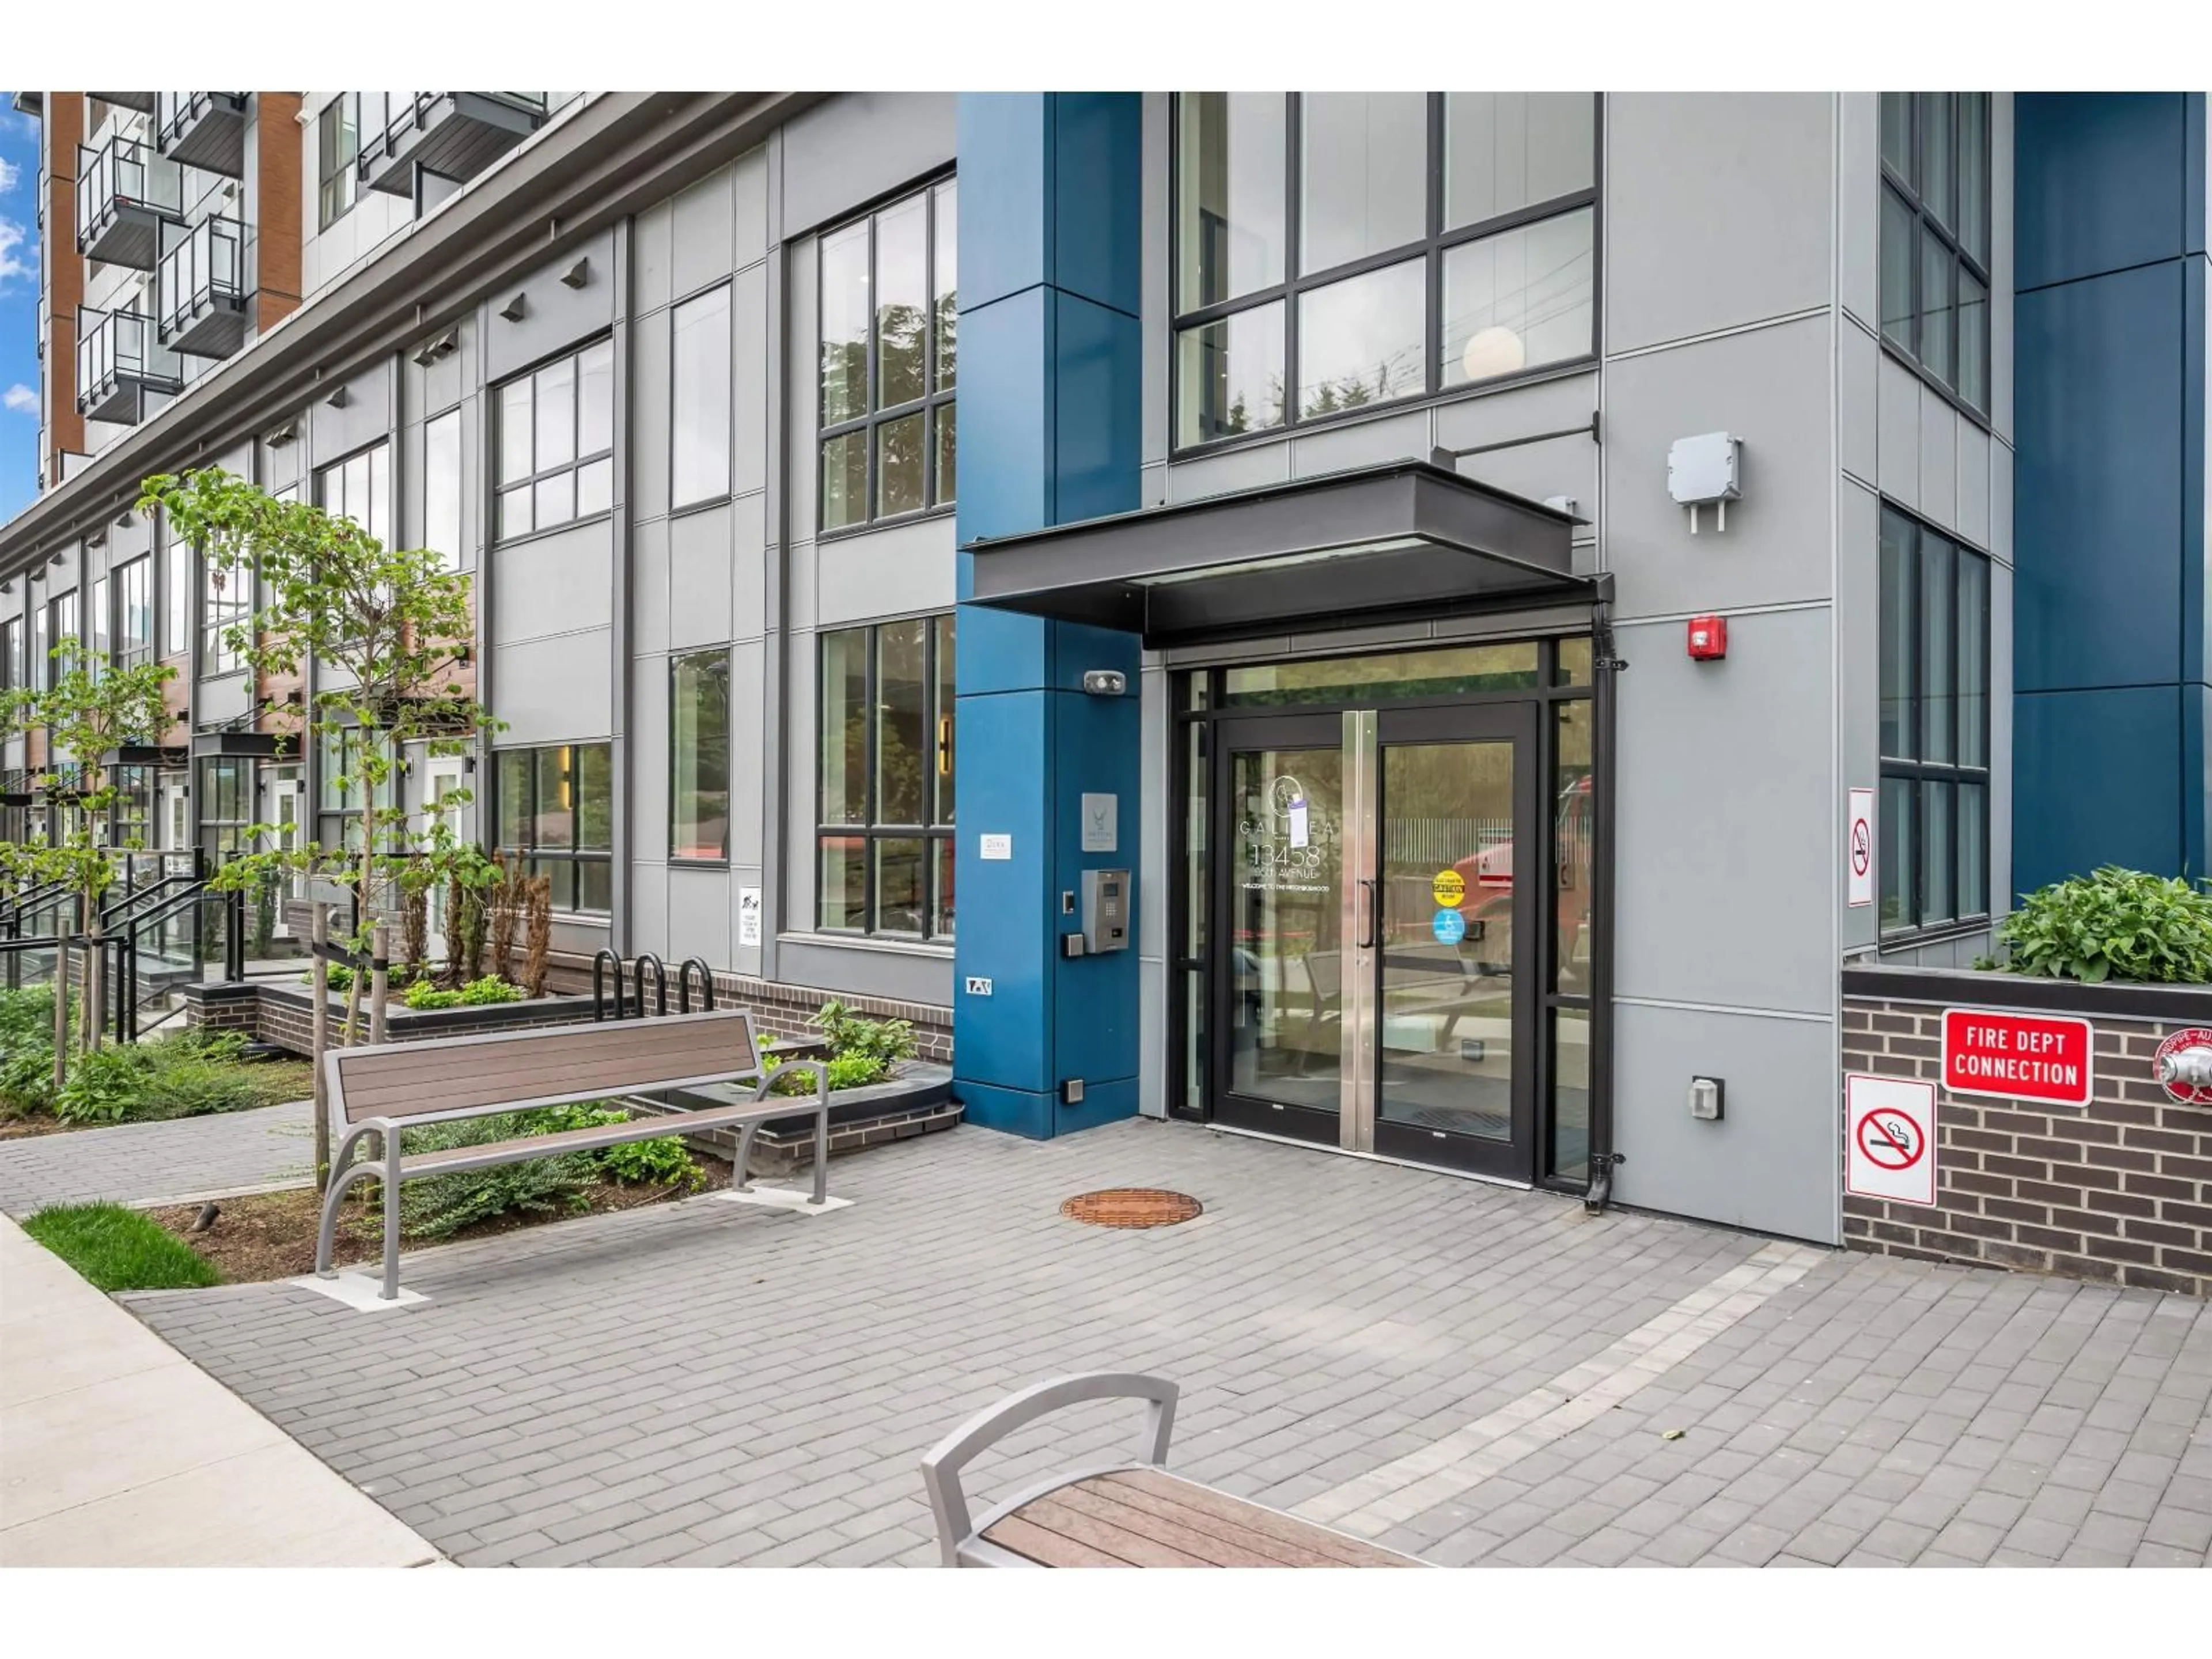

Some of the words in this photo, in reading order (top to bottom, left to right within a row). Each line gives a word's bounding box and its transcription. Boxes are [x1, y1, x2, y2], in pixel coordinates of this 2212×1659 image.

[1240, 821, 1334, 835] GALIEA
[1252, 844, 1320, 867] 13458
[1278, 868, 1317, 879] AVENUE
[1967, 1026, 2008, 1049] FIRE
[2017, 1031, 2066, 1055] DEPT
[1955, 1054, 2077, 1086] CONNECTION
